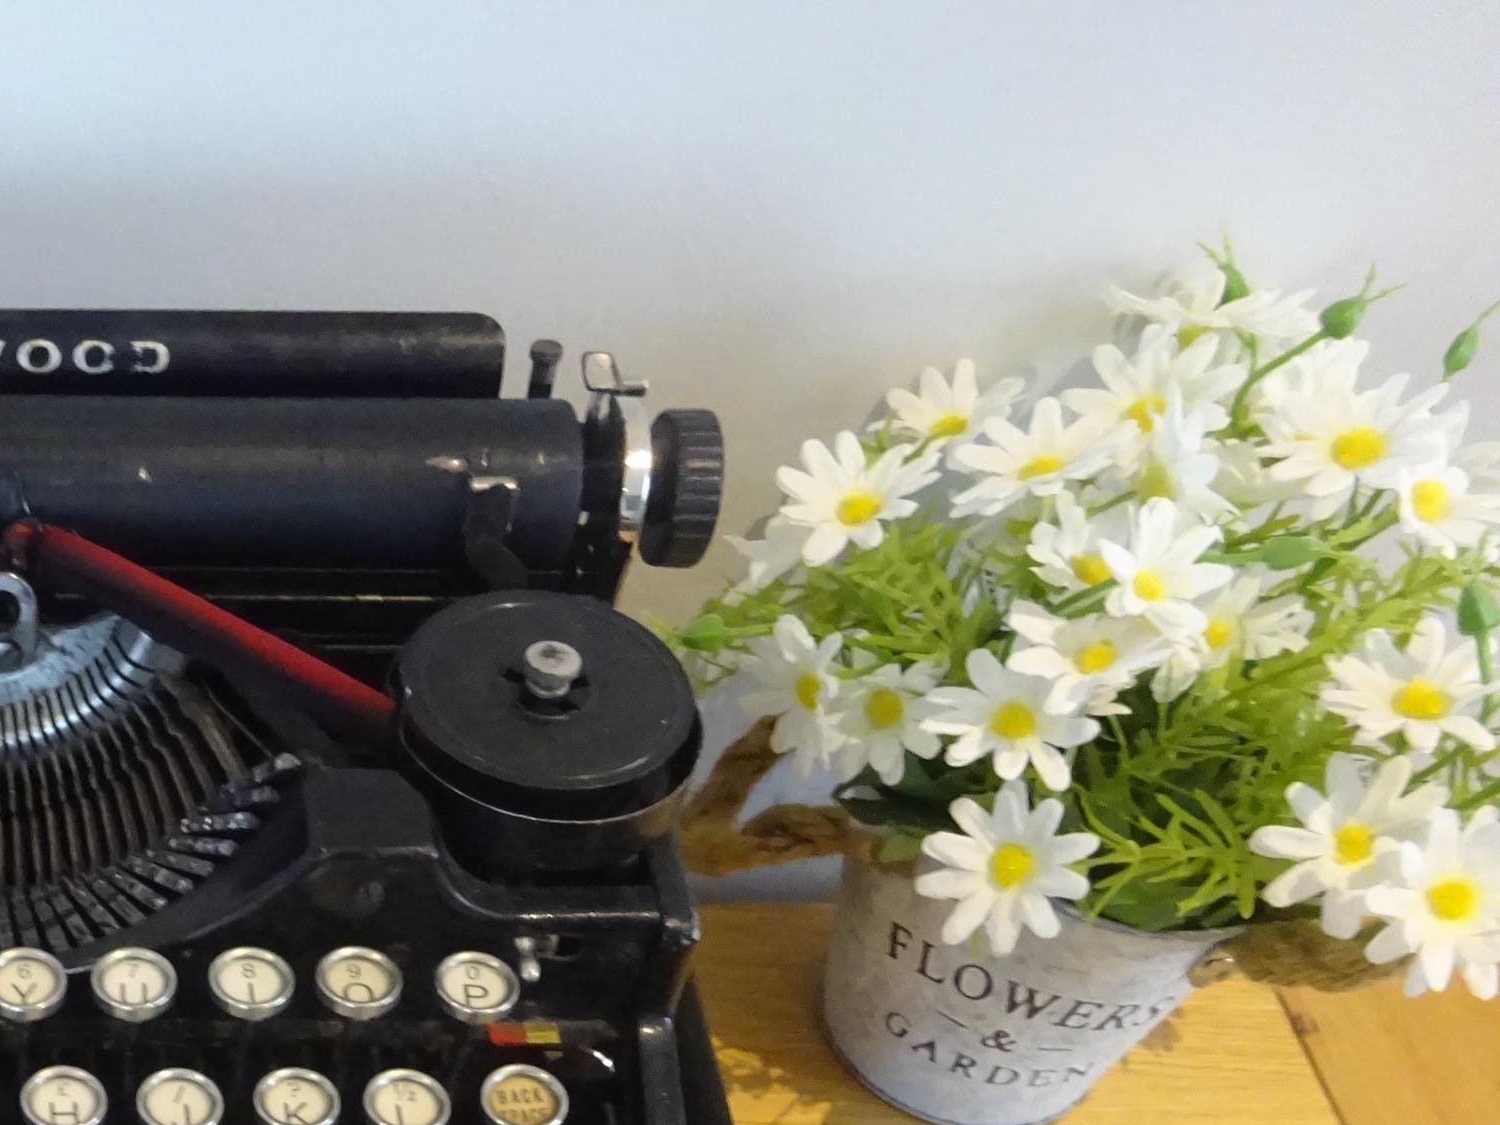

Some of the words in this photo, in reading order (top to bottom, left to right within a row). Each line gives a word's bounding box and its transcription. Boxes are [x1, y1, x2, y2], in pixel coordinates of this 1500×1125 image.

[16, 963, 32, 980] 6
[126, 962, 140, 978] 7
[240, 962, 257, 979] 8
[347, 962, 361, 979] 9
[10, 981, 38, 1004] Y
[461, 983, 489, 1008] P
[884, 1010, 1095, 1087] GARDEN
[980, 1028, 1016, 1053] &
[496, 1087, 545, 1105] BACK
[48, 1100, 80, 1125] H
[282, 1101, 310, 1125] K
